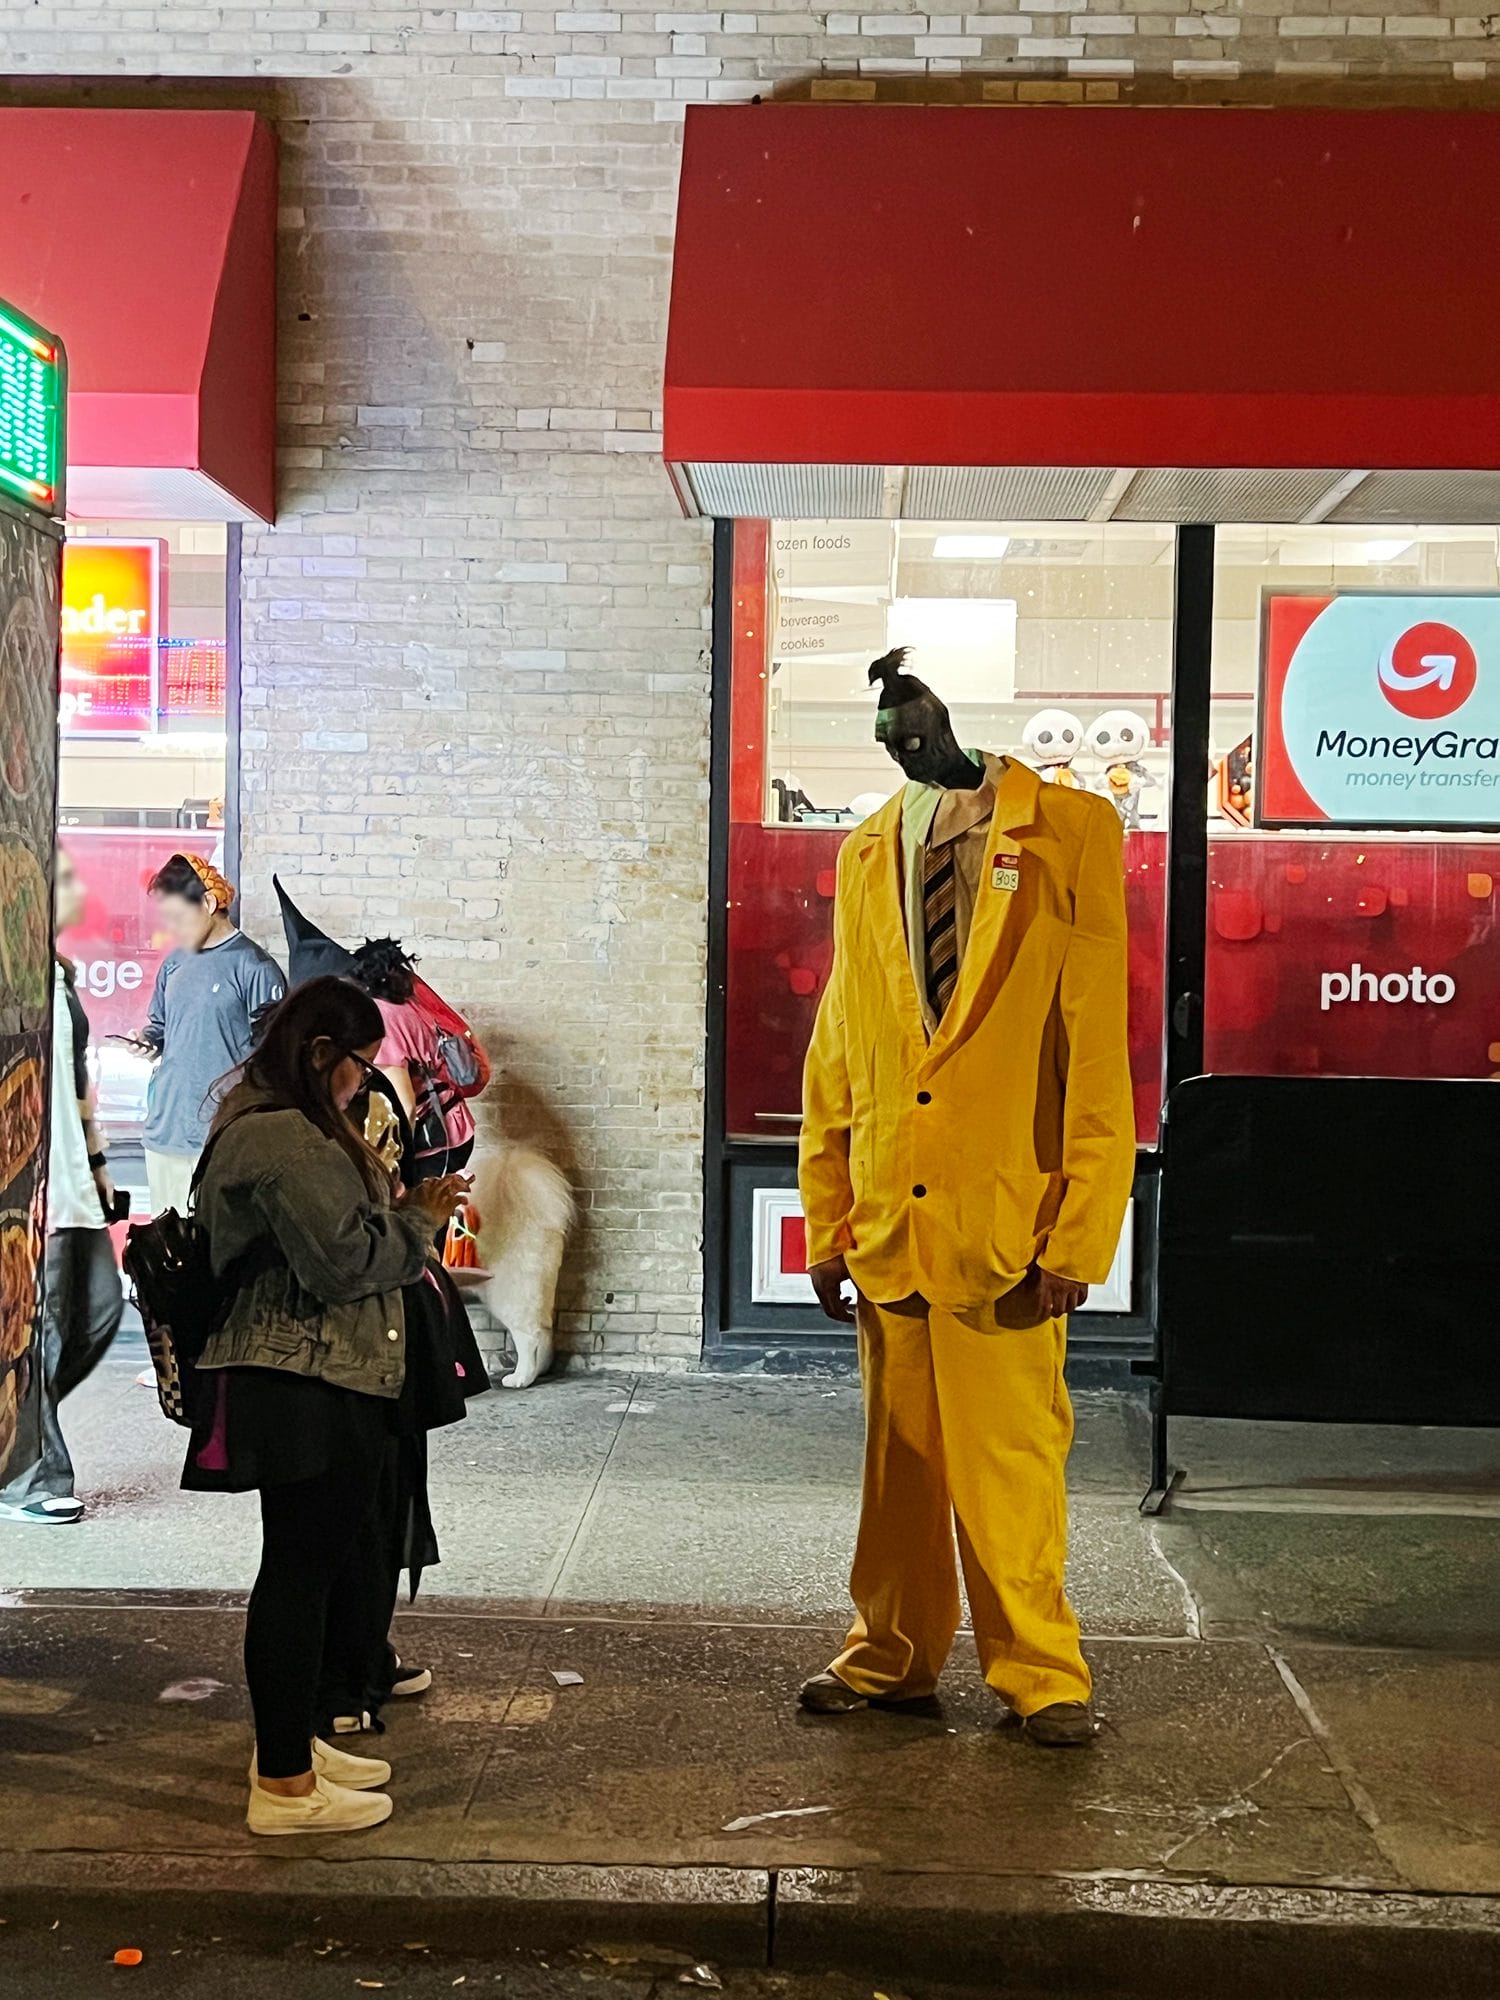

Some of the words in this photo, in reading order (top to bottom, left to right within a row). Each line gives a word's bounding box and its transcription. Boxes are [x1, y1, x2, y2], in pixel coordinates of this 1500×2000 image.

[812, 535, 851, 549] foods
[780, 614, 840, 628] beverages
[780, 637, 825, 651] cookies
[1316, 730, 1500, 766] MoneyGra
[1345, 772, 1416, 790] money
[1321, 963, 1456, 1011] photo
